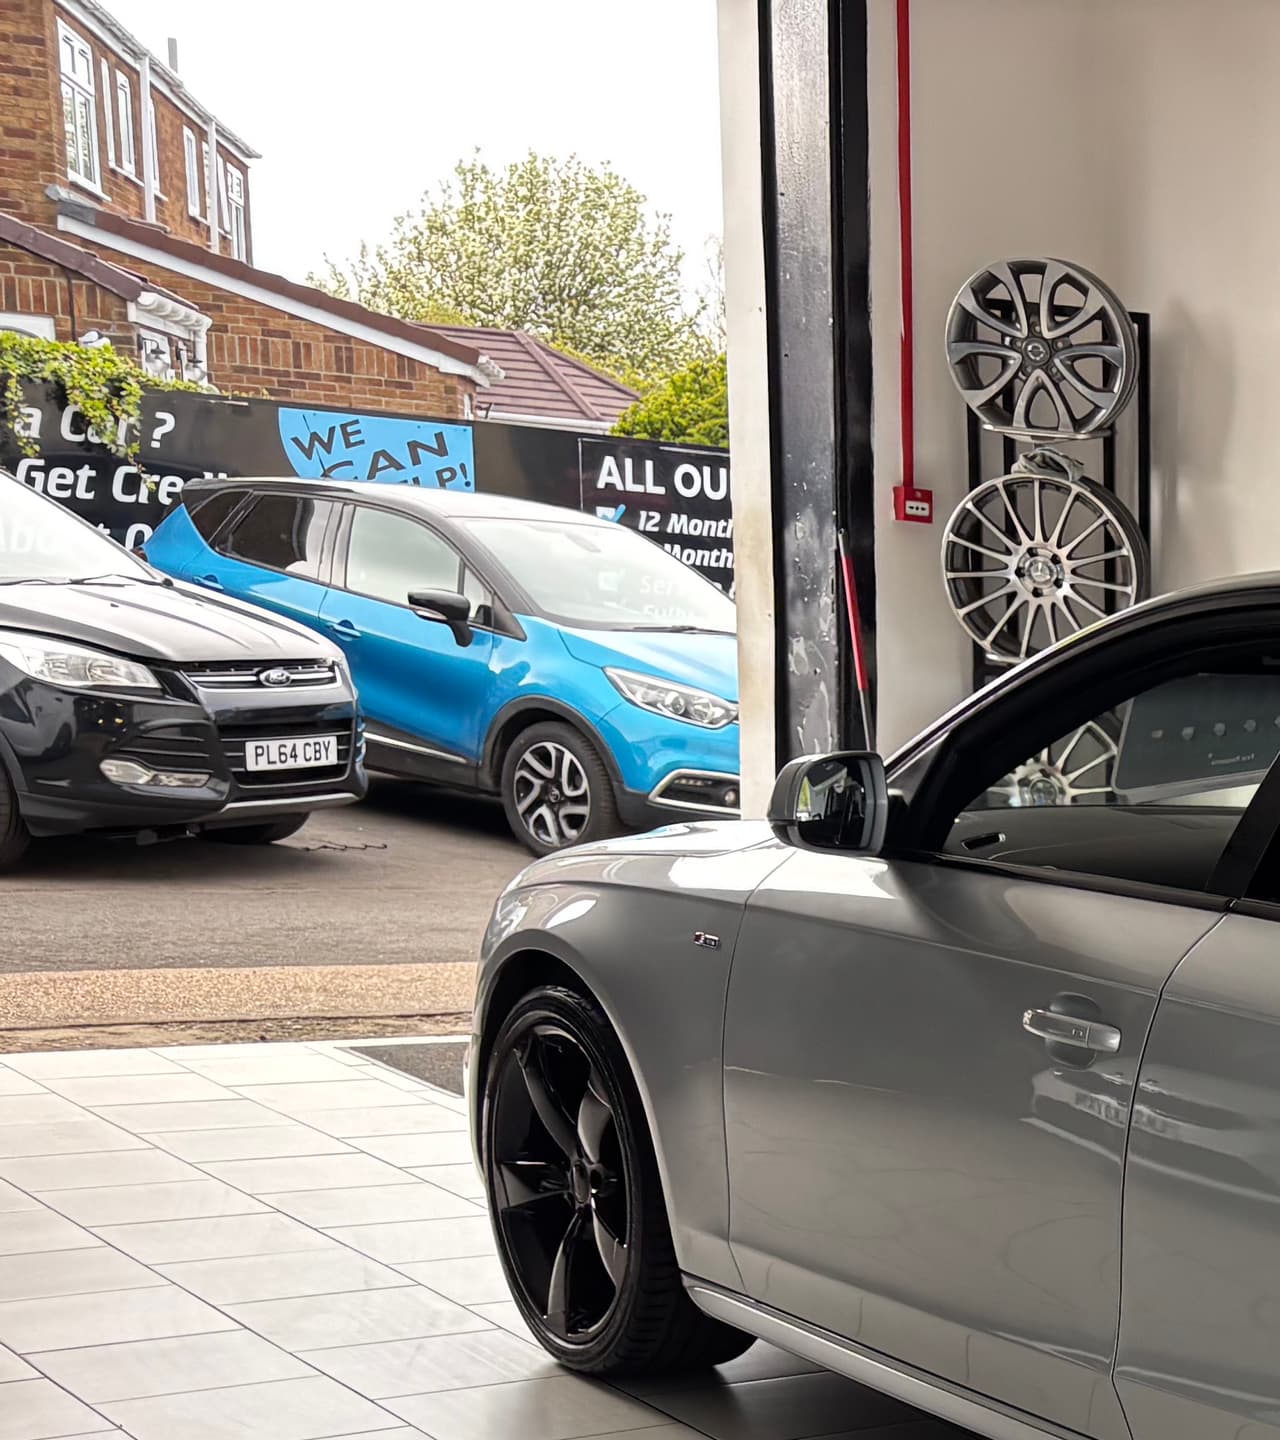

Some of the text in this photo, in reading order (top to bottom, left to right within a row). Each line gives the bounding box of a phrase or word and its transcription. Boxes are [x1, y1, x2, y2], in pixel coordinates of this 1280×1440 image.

[290, 418, 366, 461] WE
[17, 458, 97, 500] Get
[596, 455, 729, 501] ALL OU
[638, 510, 661, 532] 12
[254, 740, 331, 766] PL64 CBY
